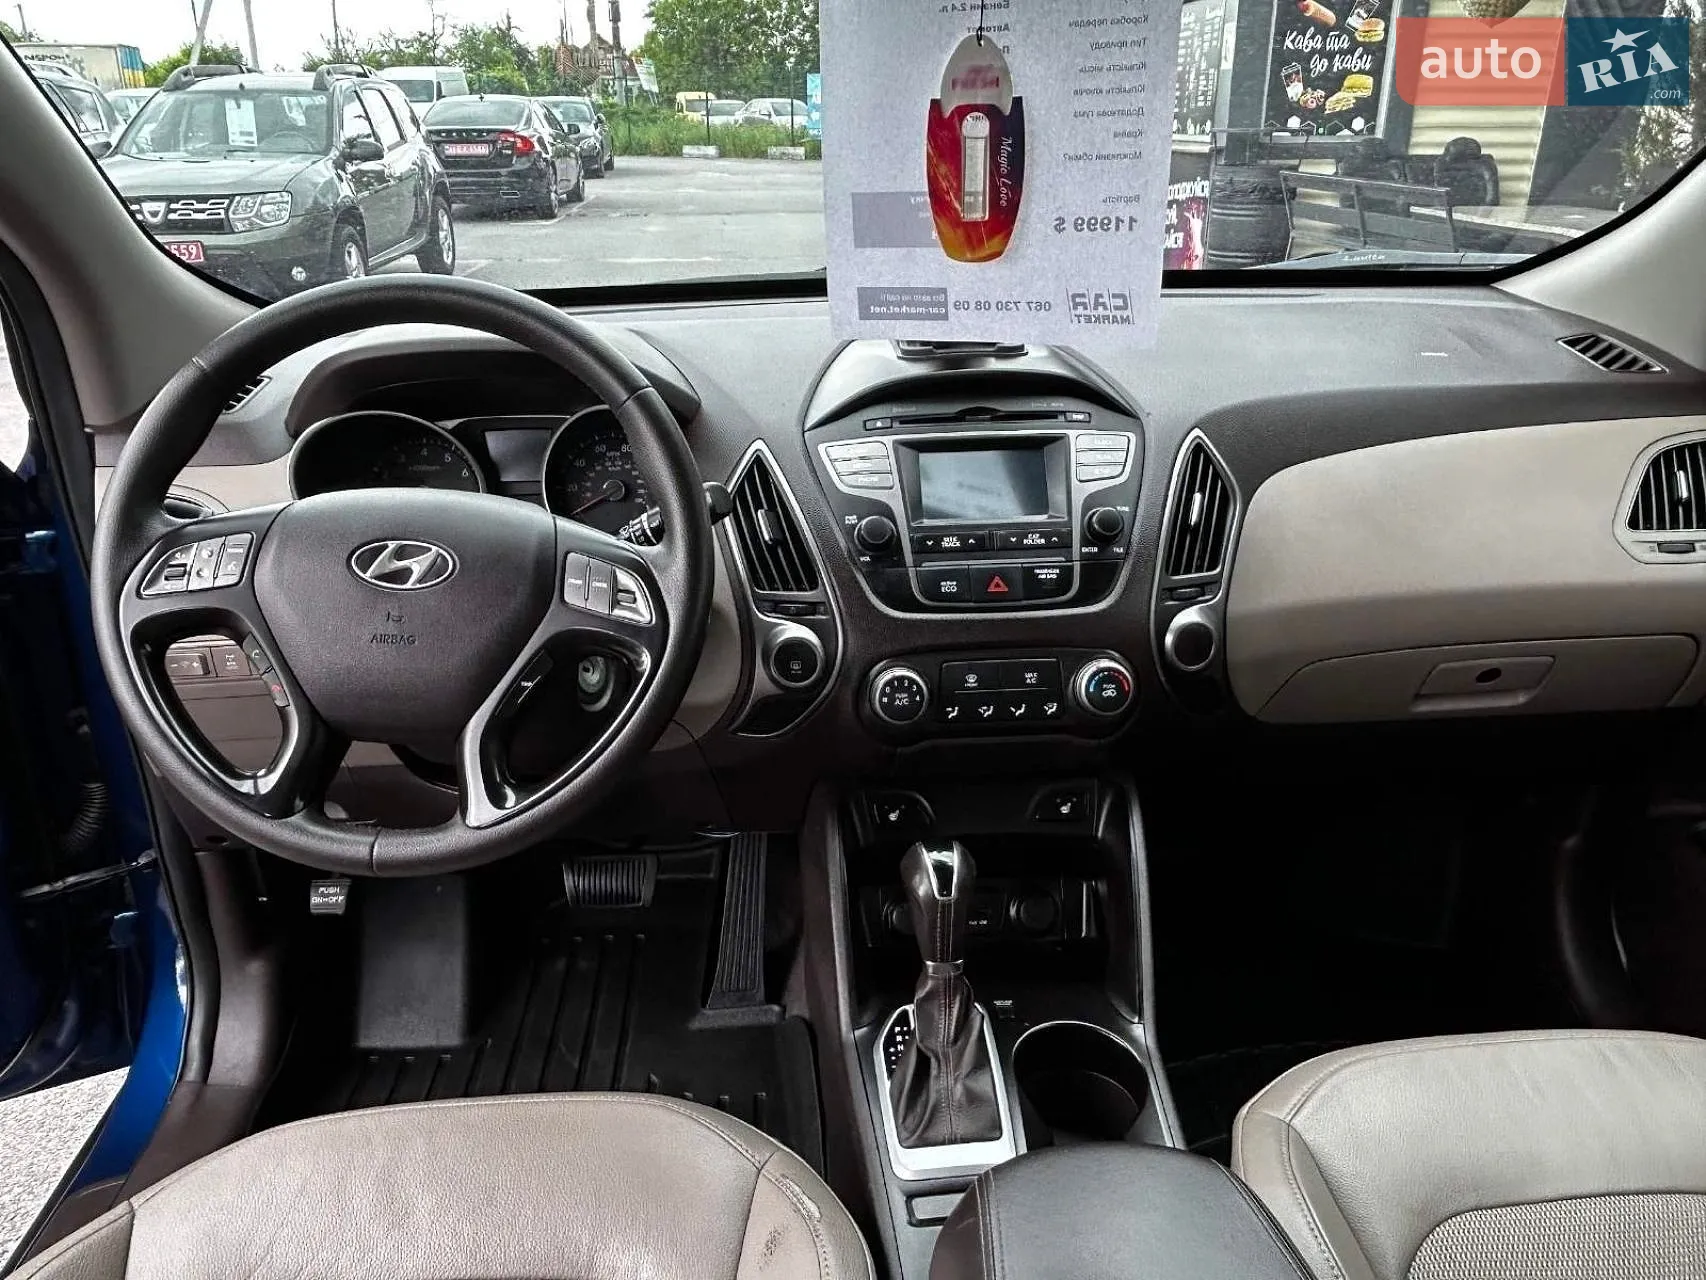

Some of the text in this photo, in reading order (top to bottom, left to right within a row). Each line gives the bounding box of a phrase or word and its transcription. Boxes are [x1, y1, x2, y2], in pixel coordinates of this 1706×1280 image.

[1283, 26, 1351, 52] Кава та
[1309, 47, 1372, 77] до кави
[370, 633, 417, 645] AIRBAG
[318, 886, 340, 894] PUSH
